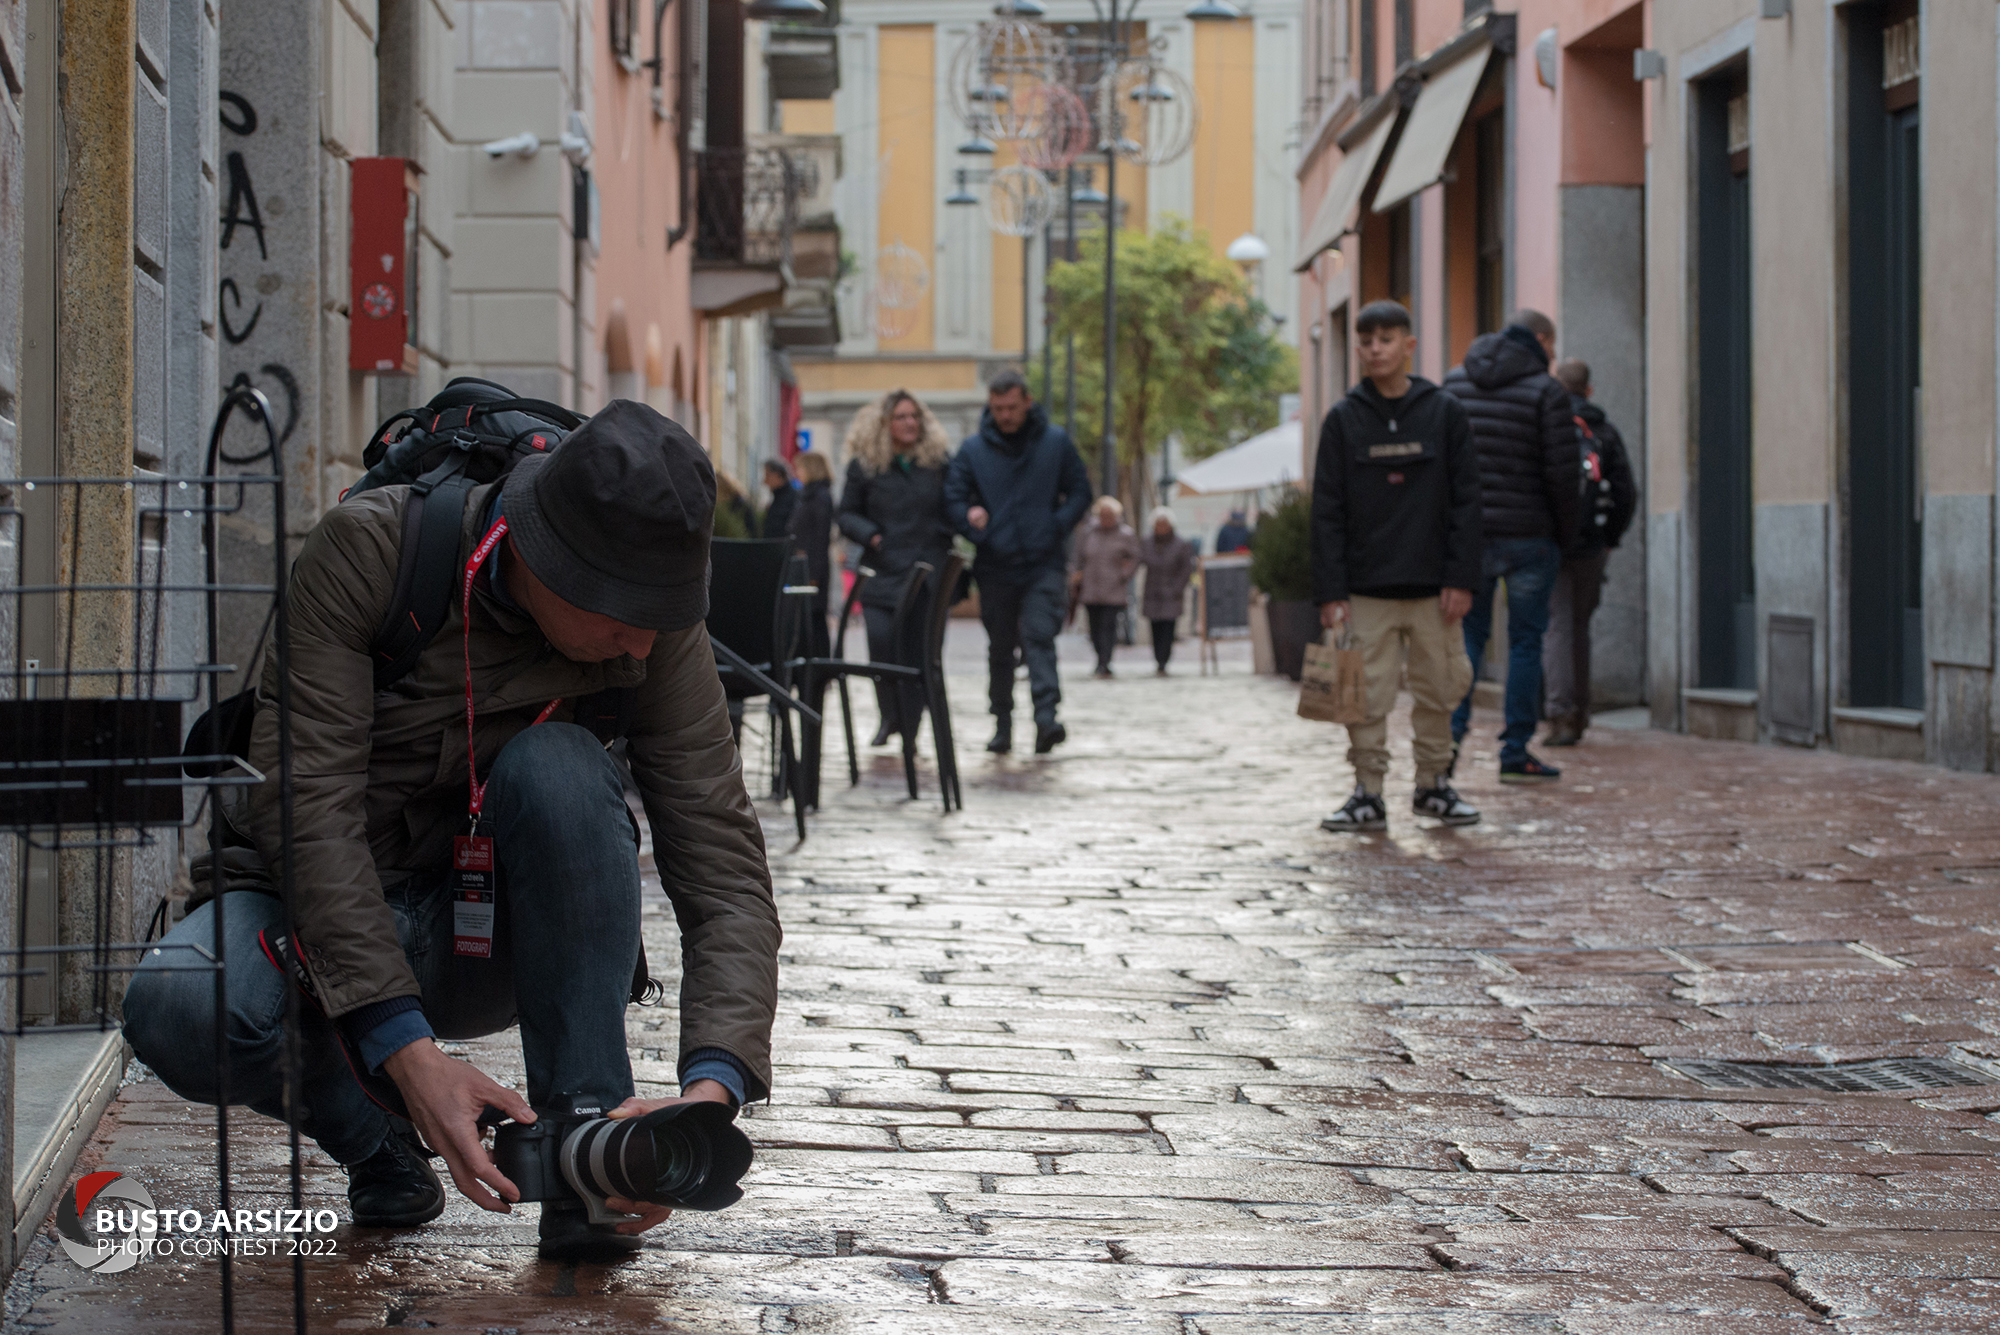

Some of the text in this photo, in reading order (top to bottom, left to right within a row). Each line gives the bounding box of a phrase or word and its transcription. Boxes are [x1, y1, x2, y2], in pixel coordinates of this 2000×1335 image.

[473, 523, 507, 563] Canon
[456, 940, 489, 954] FOTOGRAFO
[574, 1106, 602, 1115] Canon
